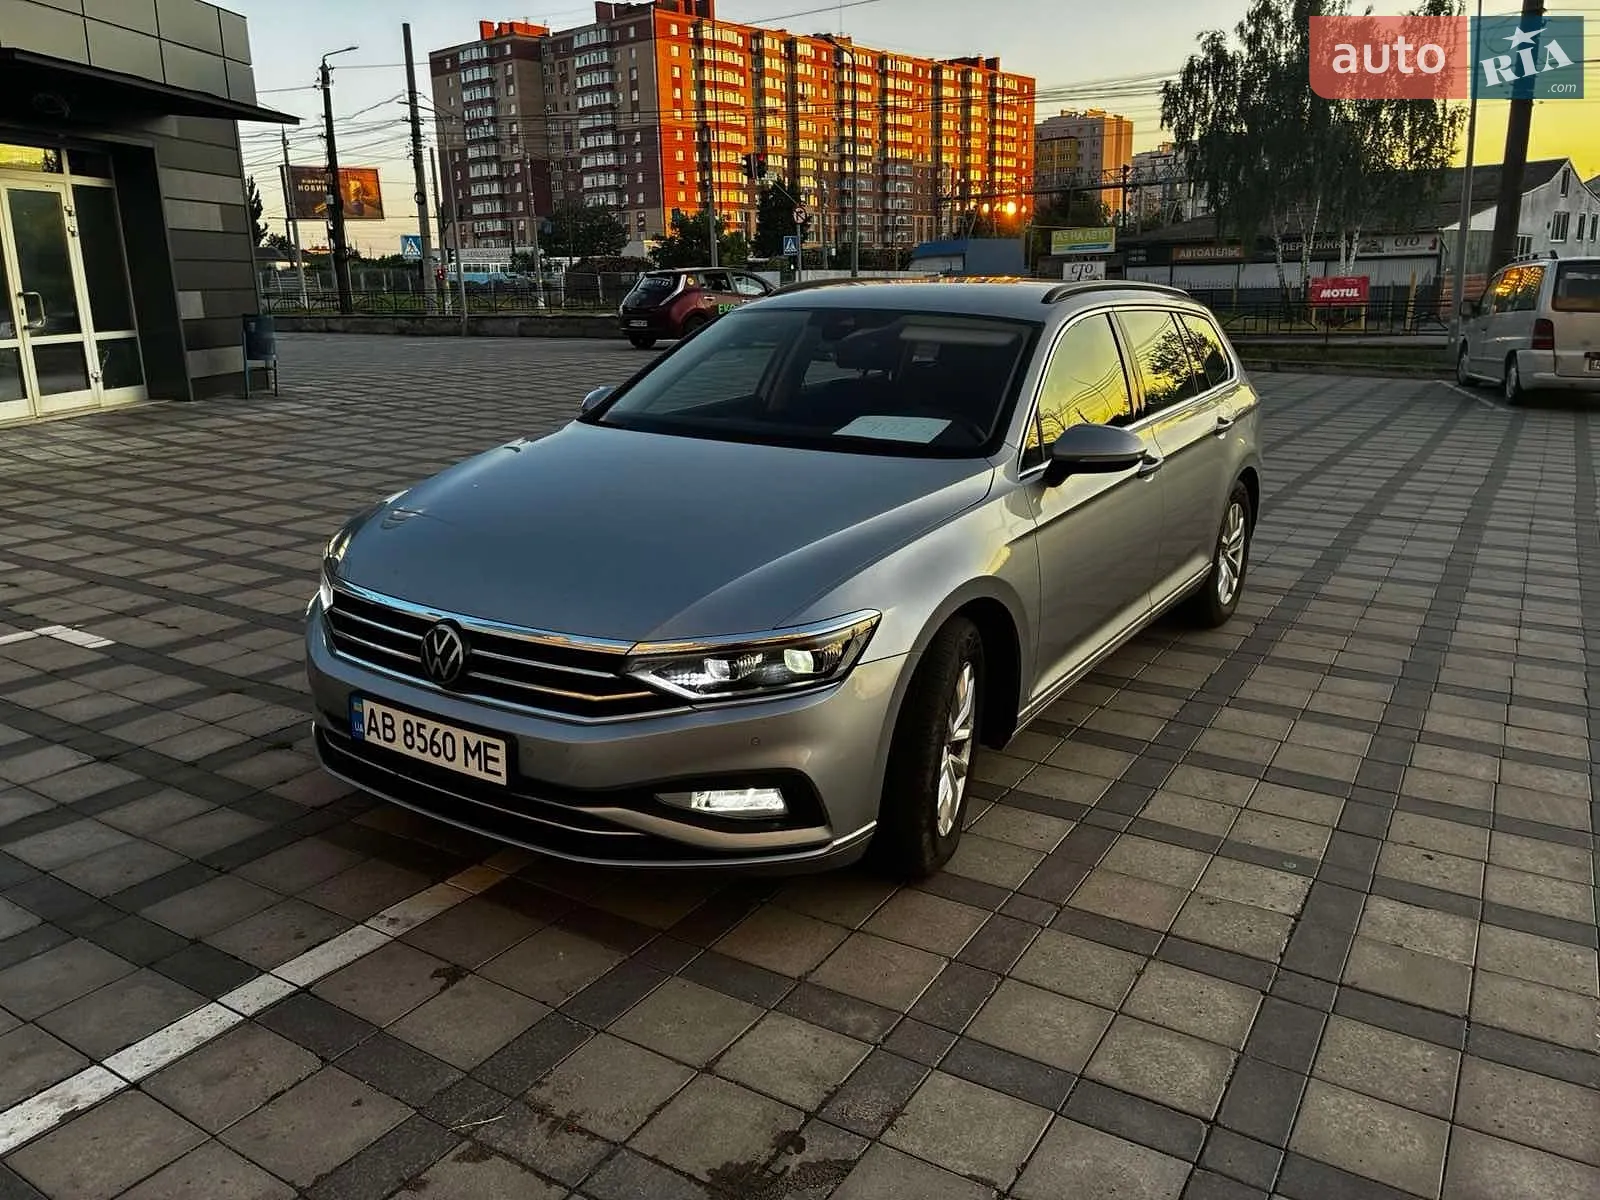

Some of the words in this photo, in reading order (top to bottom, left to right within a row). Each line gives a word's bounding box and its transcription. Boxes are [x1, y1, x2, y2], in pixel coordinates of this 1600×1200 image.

[1320, 288, 1360, 298] MOTUL
[366, 708, 396, 743] AB
[403, 719, 456, 762] 8560
[463, 735, 502, 777] ME
